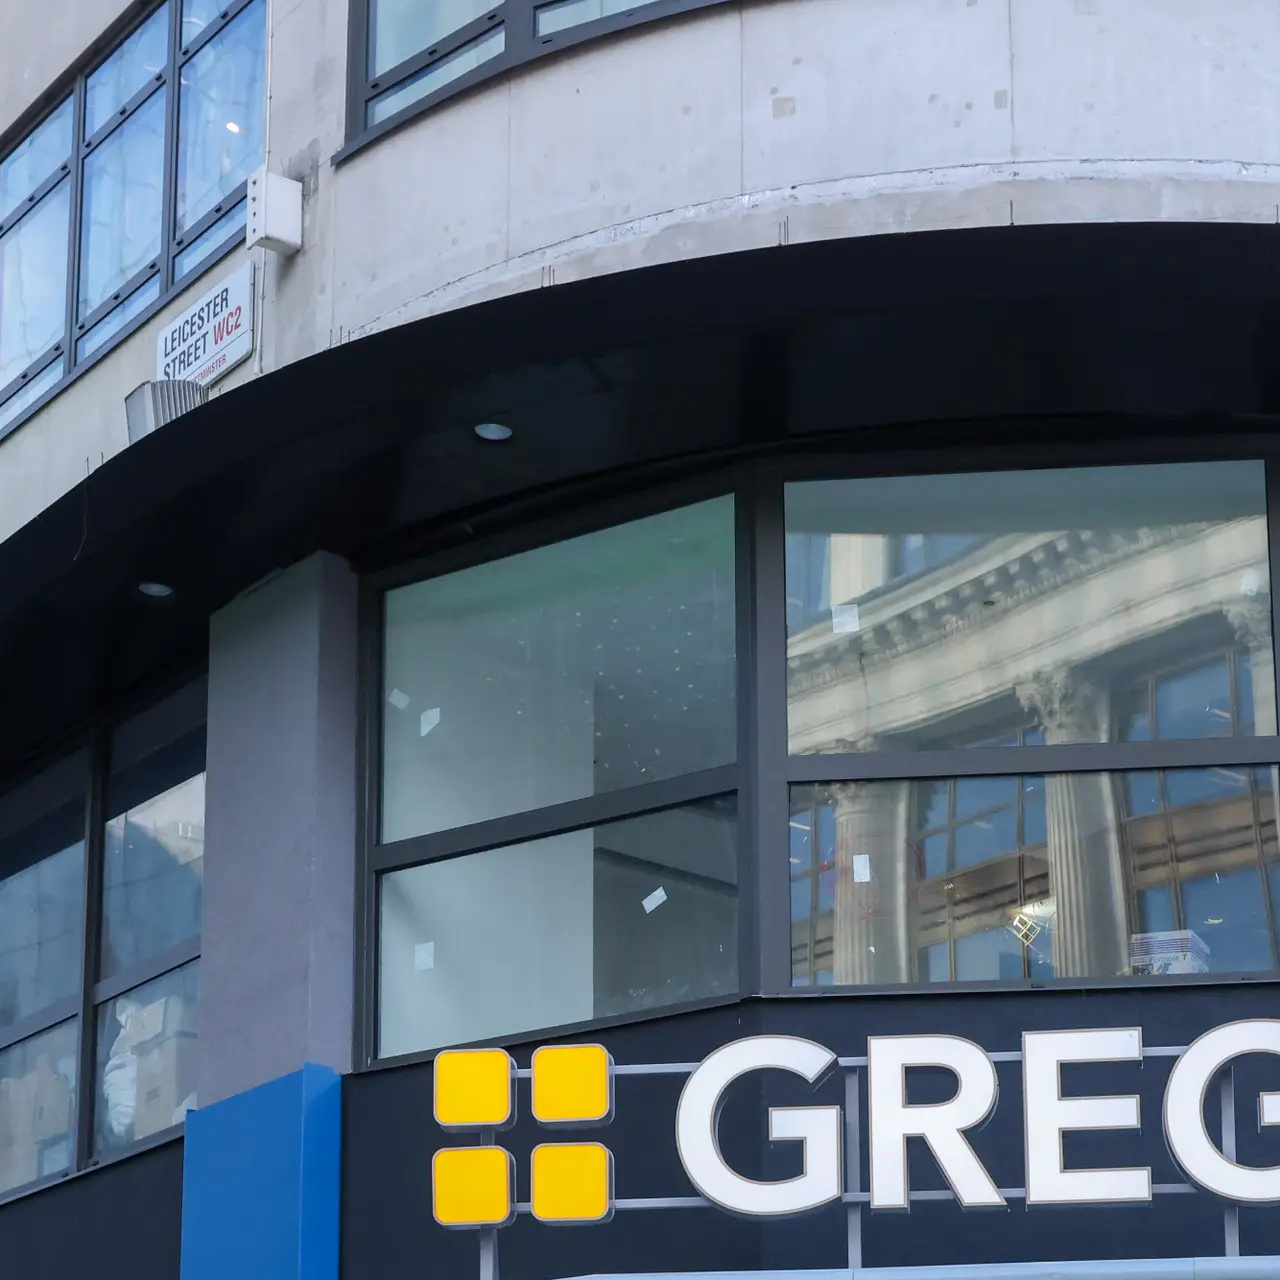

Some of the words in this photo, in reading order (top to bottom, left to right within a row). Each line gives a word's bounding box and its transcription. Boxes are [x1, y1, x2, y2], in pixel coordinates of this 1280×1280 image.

[163, 331, 209, 380] STREET
[214, 305, 242, 345] WC2
[164, 287, 229, 359] LEICESTER
